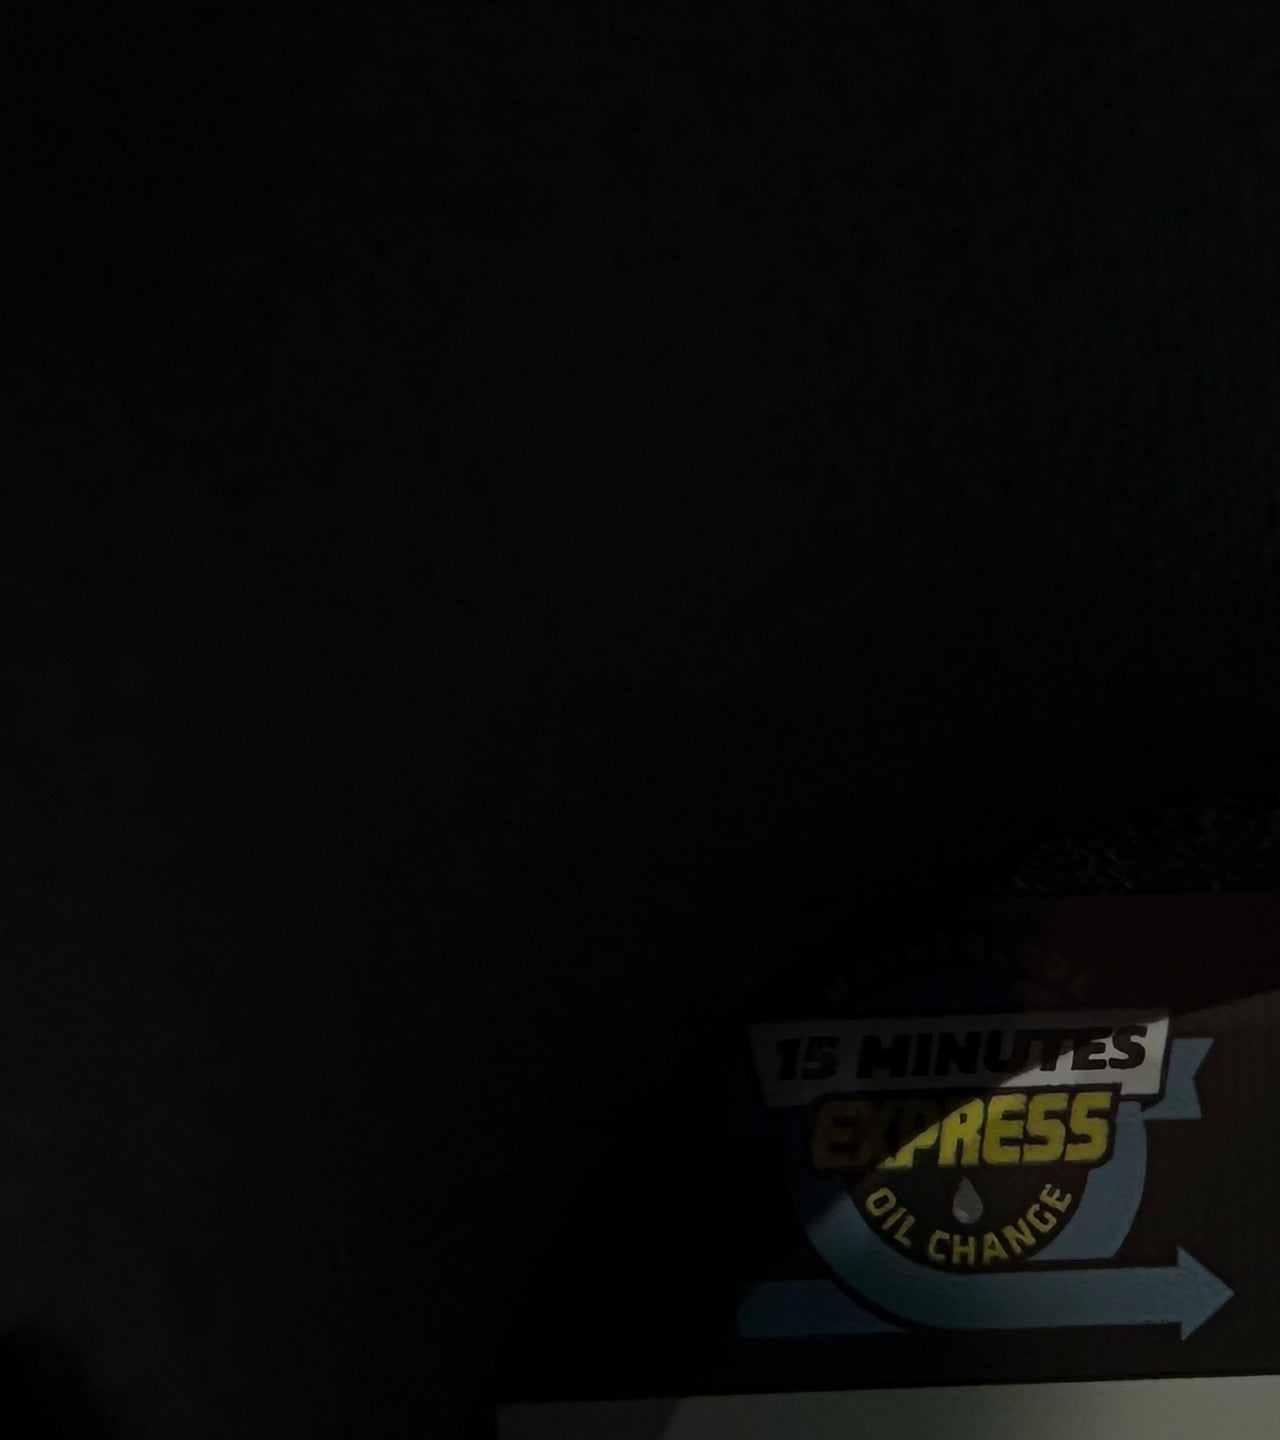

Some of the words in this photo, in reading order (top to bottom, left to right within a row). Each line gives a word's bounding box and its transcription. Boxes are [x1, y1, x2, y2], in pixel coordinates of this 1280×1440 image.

[774, 1034, 838, 1081] 15
[858, 1025, 1147, 1079] MINUTES
[811, 1089, 1115, 1171] EXPRESS
[863, 1186, 915, 1250] OIL
[927, 1182, 1075, 1266] CHANGE
